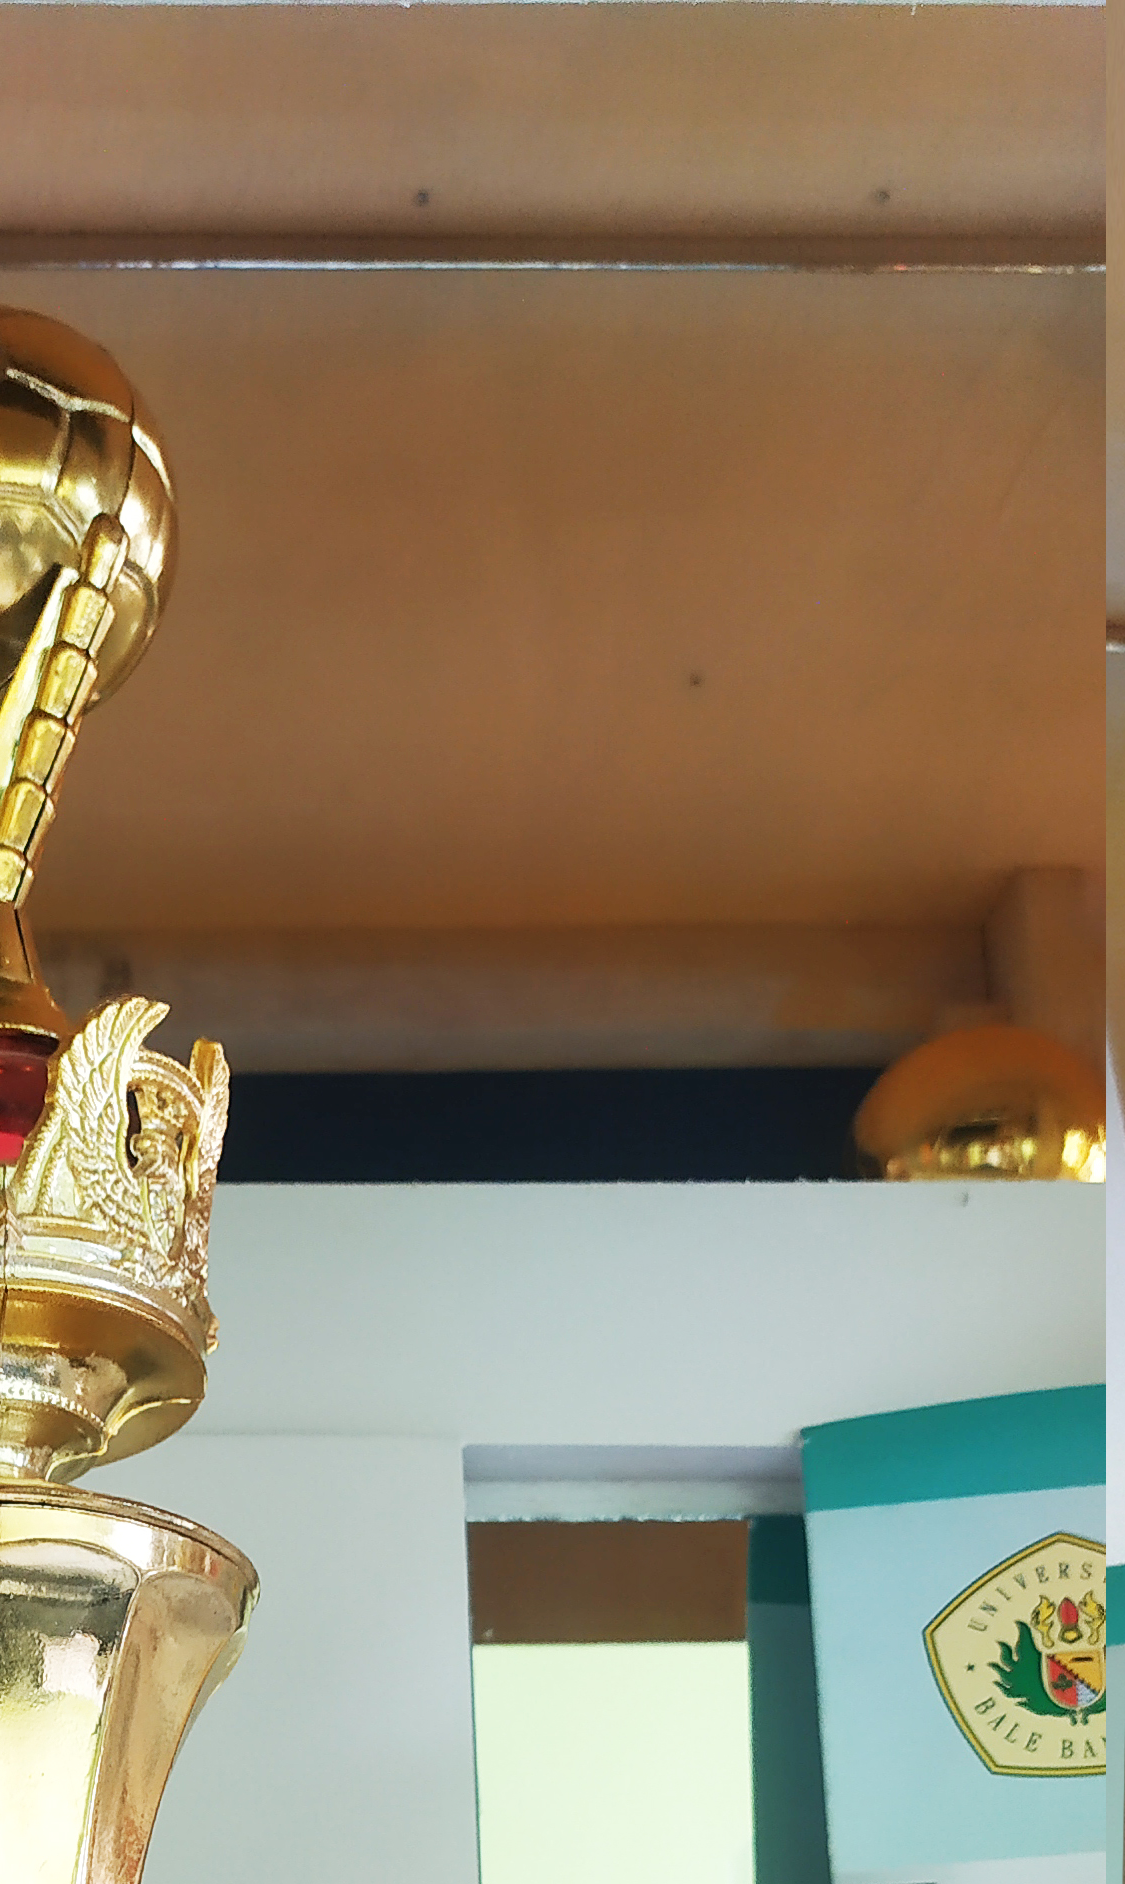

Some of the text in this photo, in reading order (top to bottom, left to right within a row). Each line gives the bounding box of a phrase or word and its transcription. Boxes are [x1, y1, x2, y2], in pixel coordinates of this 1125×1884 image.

[967, 1562, 1106, 1632] UNIVERS
[974, 1697, 1106, 1759] BALE BA
